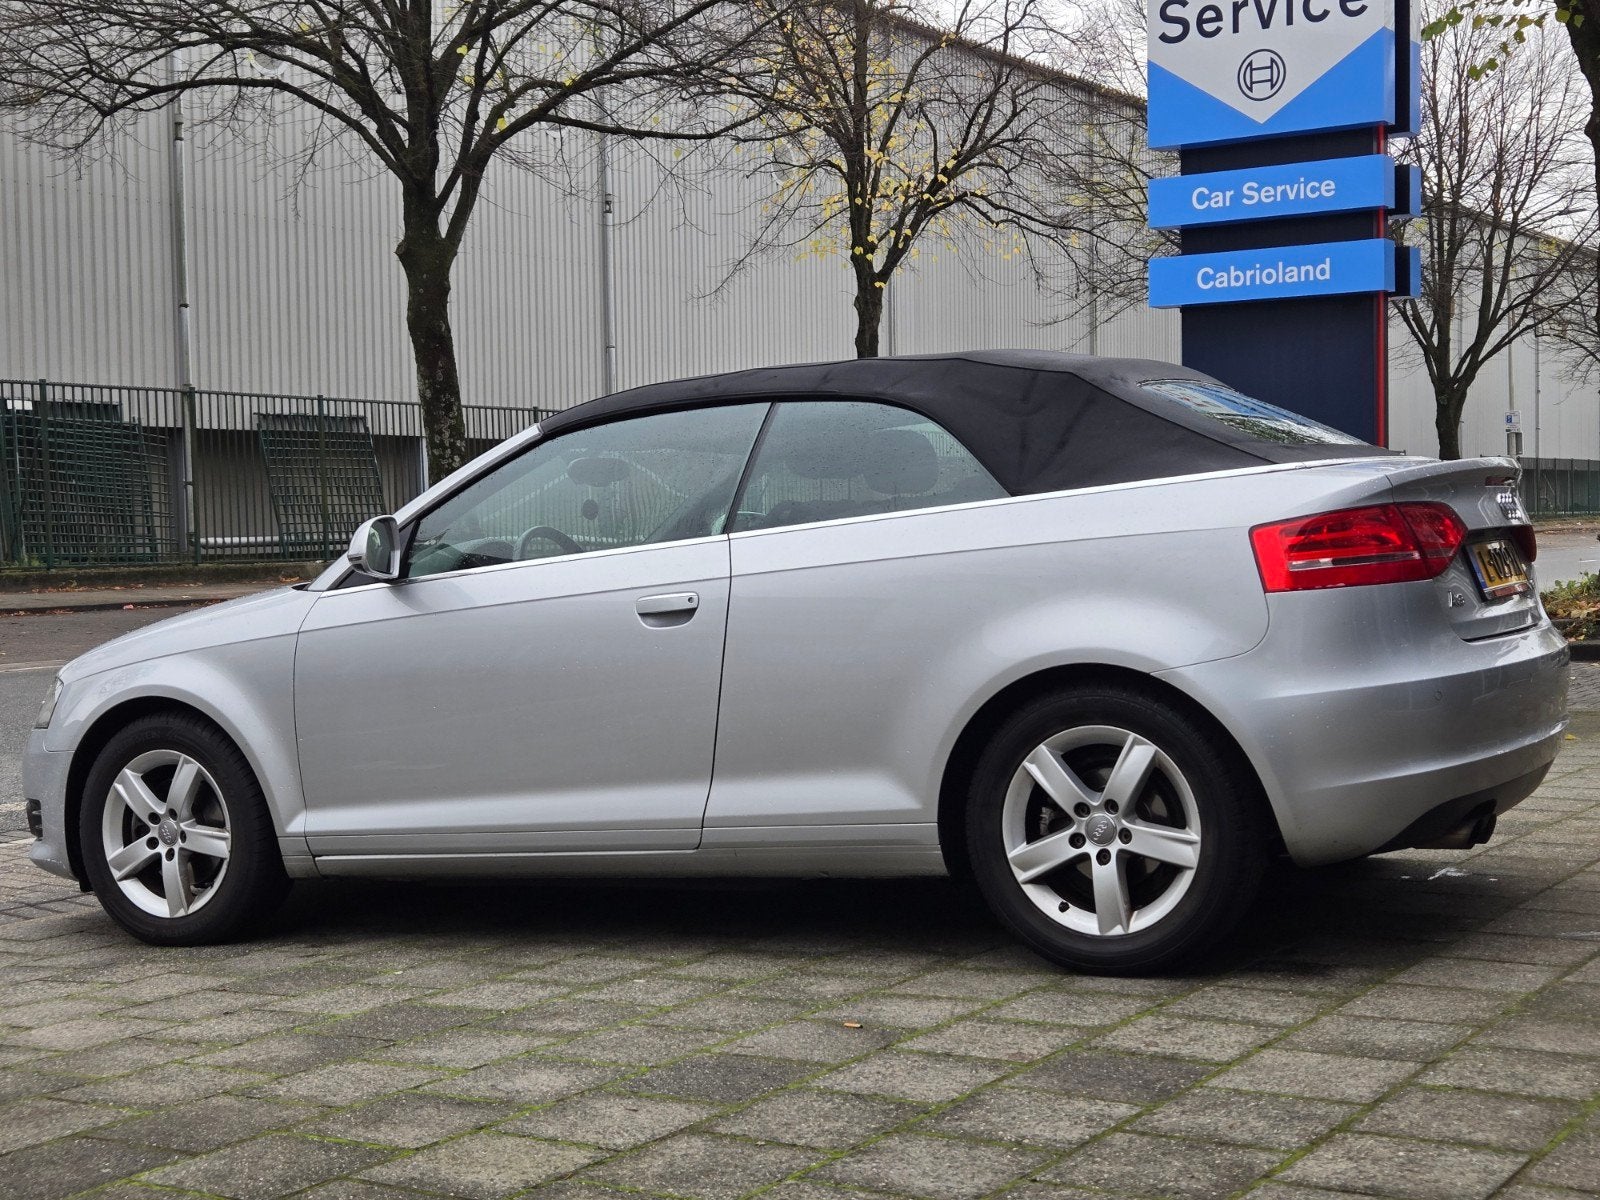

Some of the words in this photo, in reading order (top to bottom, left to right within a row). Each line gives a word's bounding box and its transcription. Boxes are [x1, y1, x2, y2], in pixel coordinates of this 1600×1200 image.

[1191, 187, 1235, 210] Car
[1242, 177, 1336, 205] Service
[1196, 257, 1331, 290] Cabrioland
